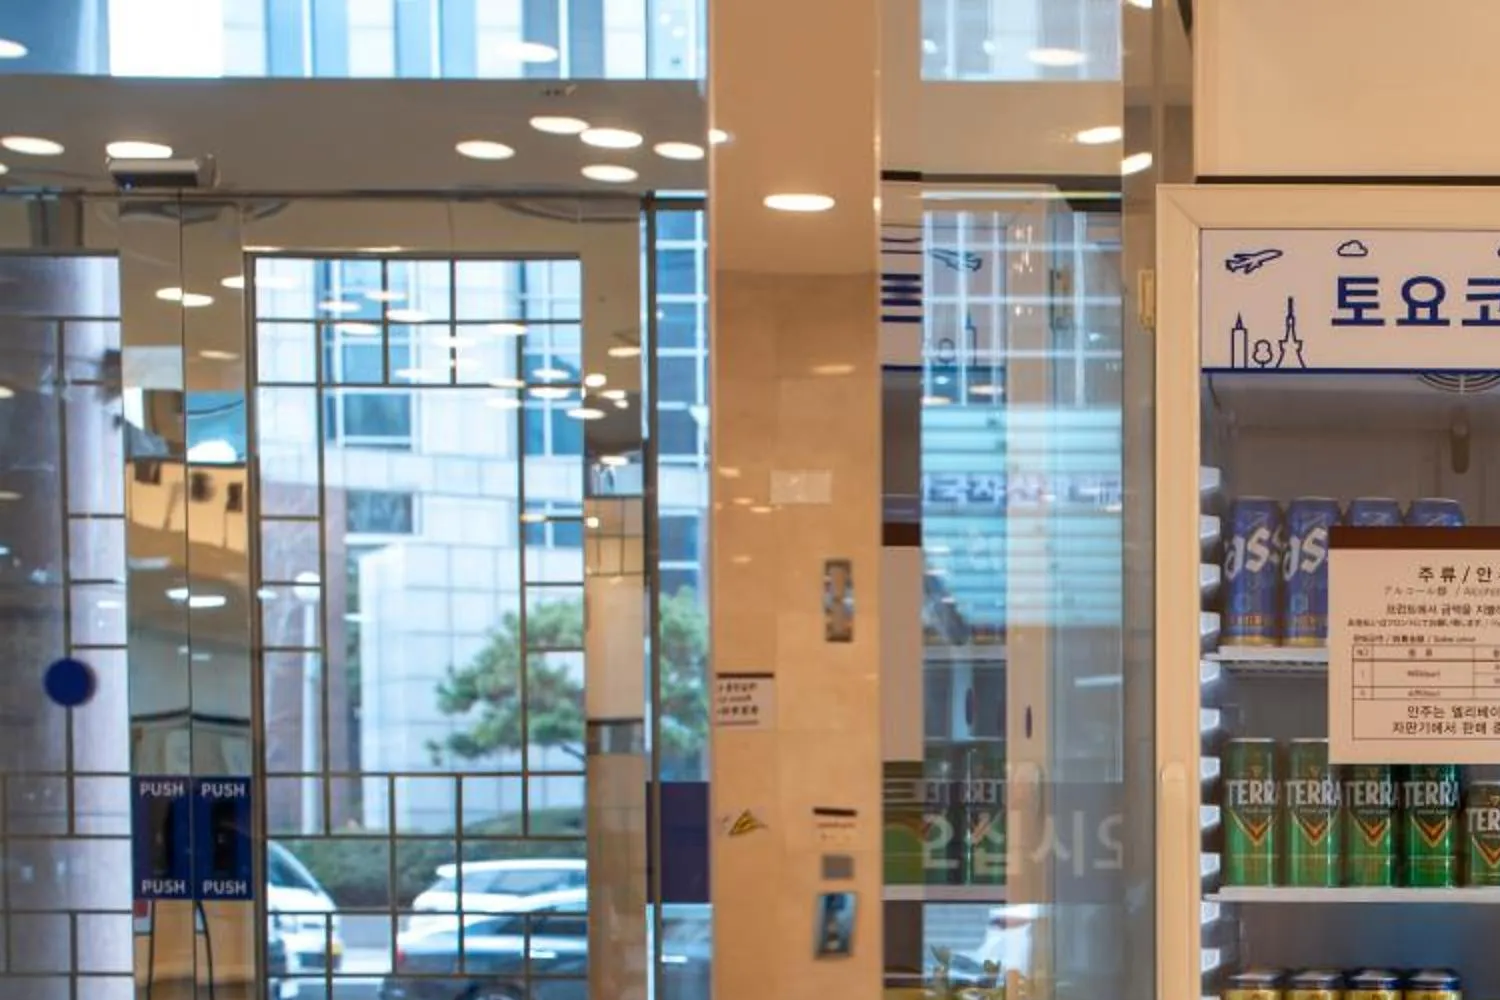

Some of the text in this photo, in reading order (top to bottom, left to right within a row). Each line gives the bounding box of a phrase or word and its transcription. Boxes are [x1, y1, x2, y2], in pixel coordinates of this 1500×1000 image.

[140, 783, 184, 796] PUSH
[201, 783, 245, 797] PUSH
[142, 880, 186, 893] PUSH
[203, 881, 247, 894] PUSH
